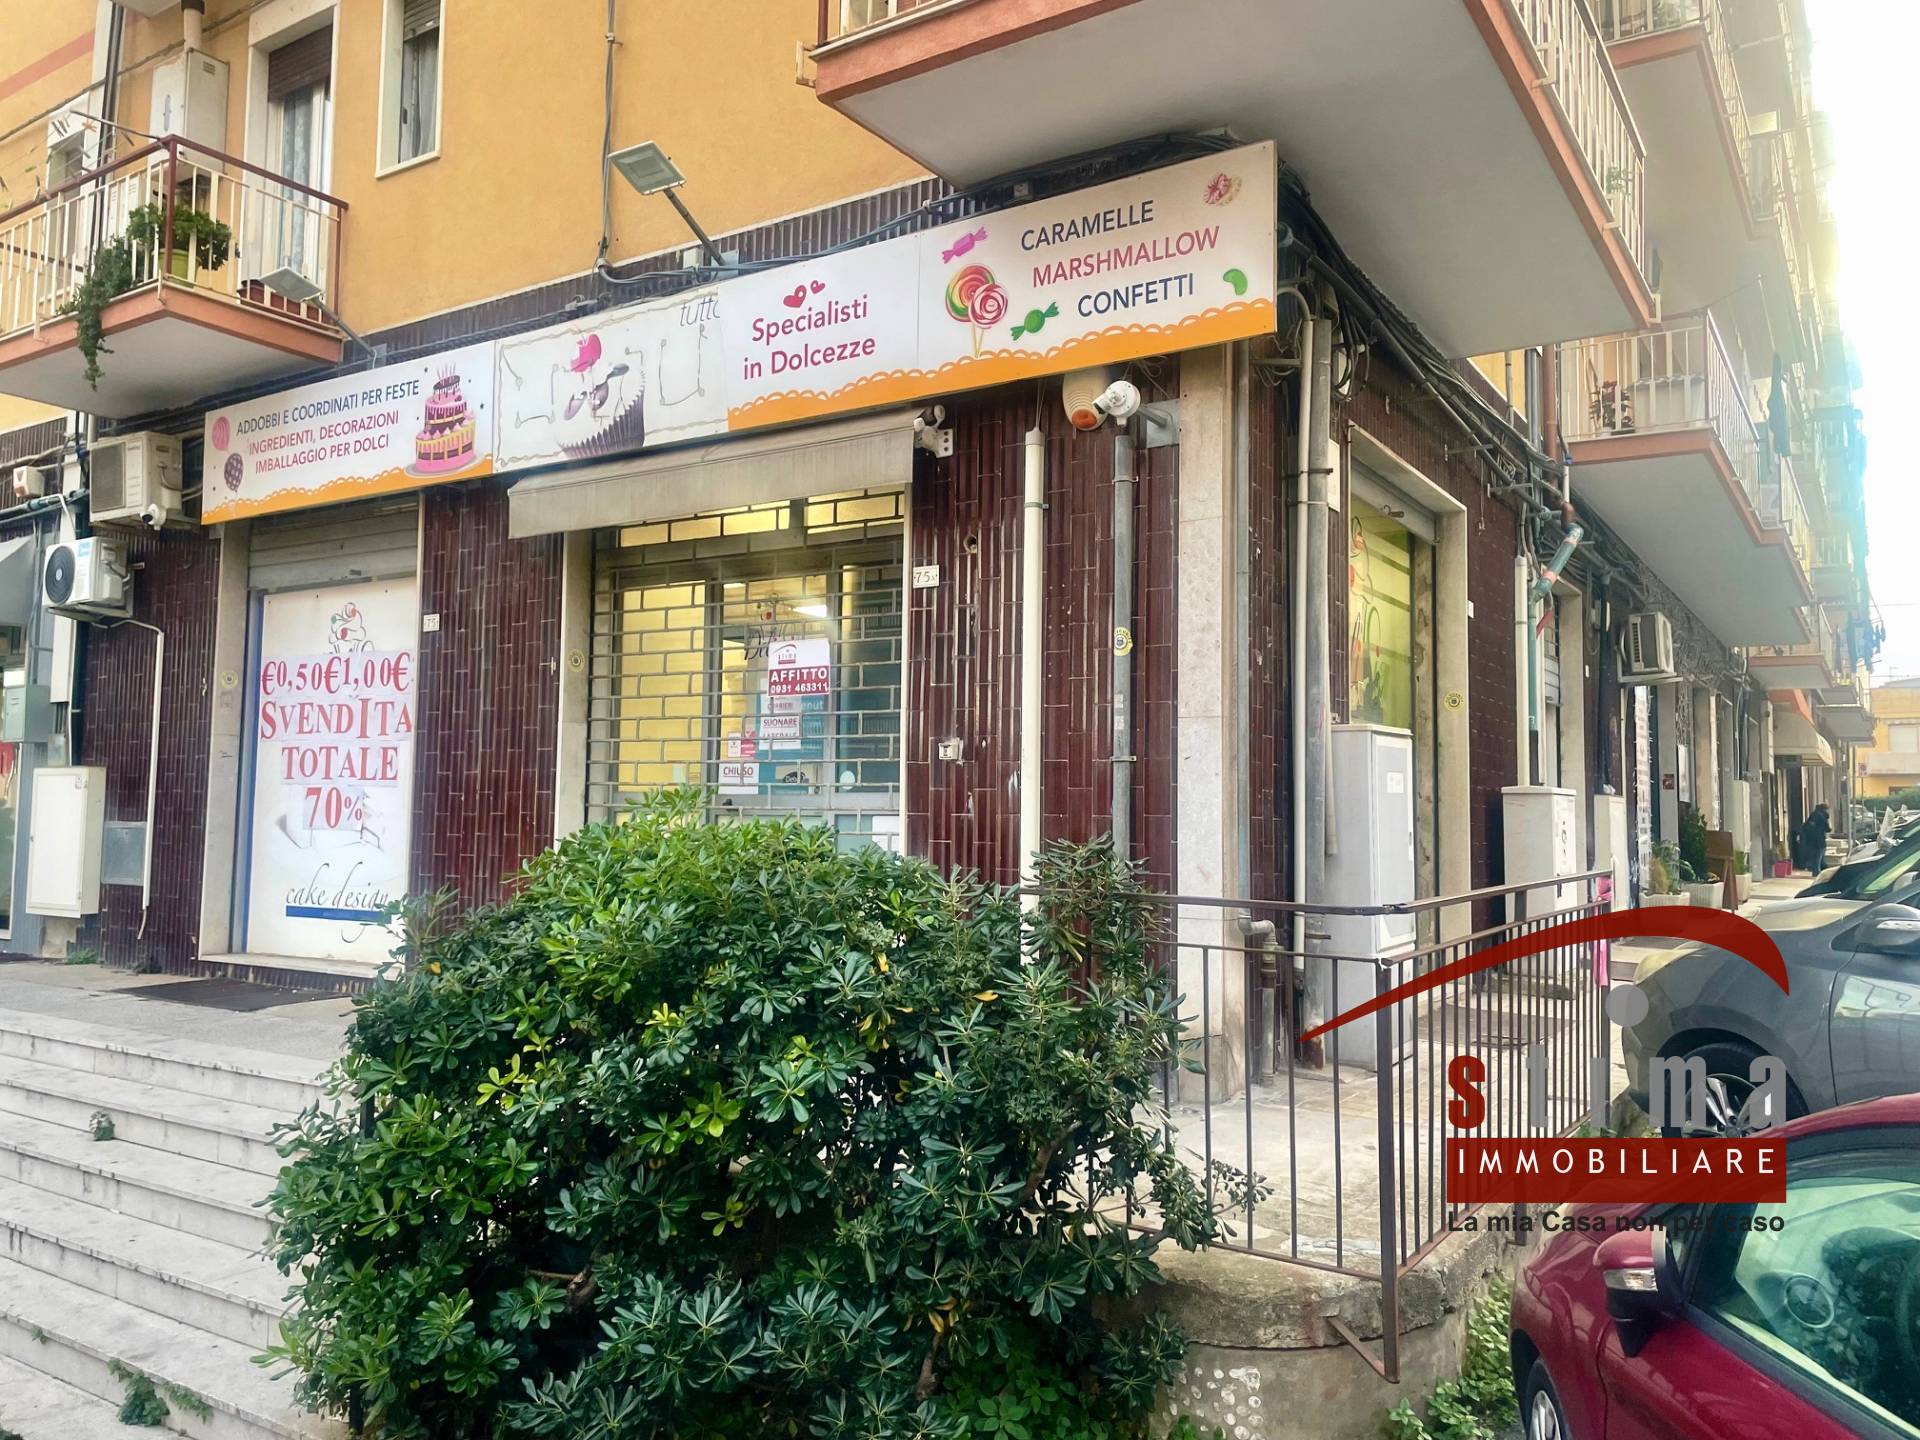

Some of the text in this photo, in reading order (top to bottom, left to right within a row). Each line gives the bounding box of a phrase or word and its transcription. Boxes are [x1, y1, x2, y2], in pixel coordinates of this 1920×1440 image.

[1021, 200, 1154, 251] CARAMELLE
[1033, 226, 1220, 288] MARSHMALLOW
[1077, 272, 1193, 317] CONFETTI
[752, 294, 867, 346] Specialisti
[744, 338, 876, 380] in Dolcezze
[236, 379, 420, 437] ADDOBBI E COORDINATI PER FESTE
[248, 410, 399, 456] INGREDIENTI, DECORAZIONI
[255, 434, 389, 475] IMBALLAGGIO PER DOLCI
[770, 667, 828, 683] AFFITTO
[770, 682, 829, 694] 0931 463311
[261, 698, 413, 740] SVENDITA
[281, 746, 399, 781] TOTALE
[305, 786, 363, 829] 70%
[286, 862, 330, 906] cake
